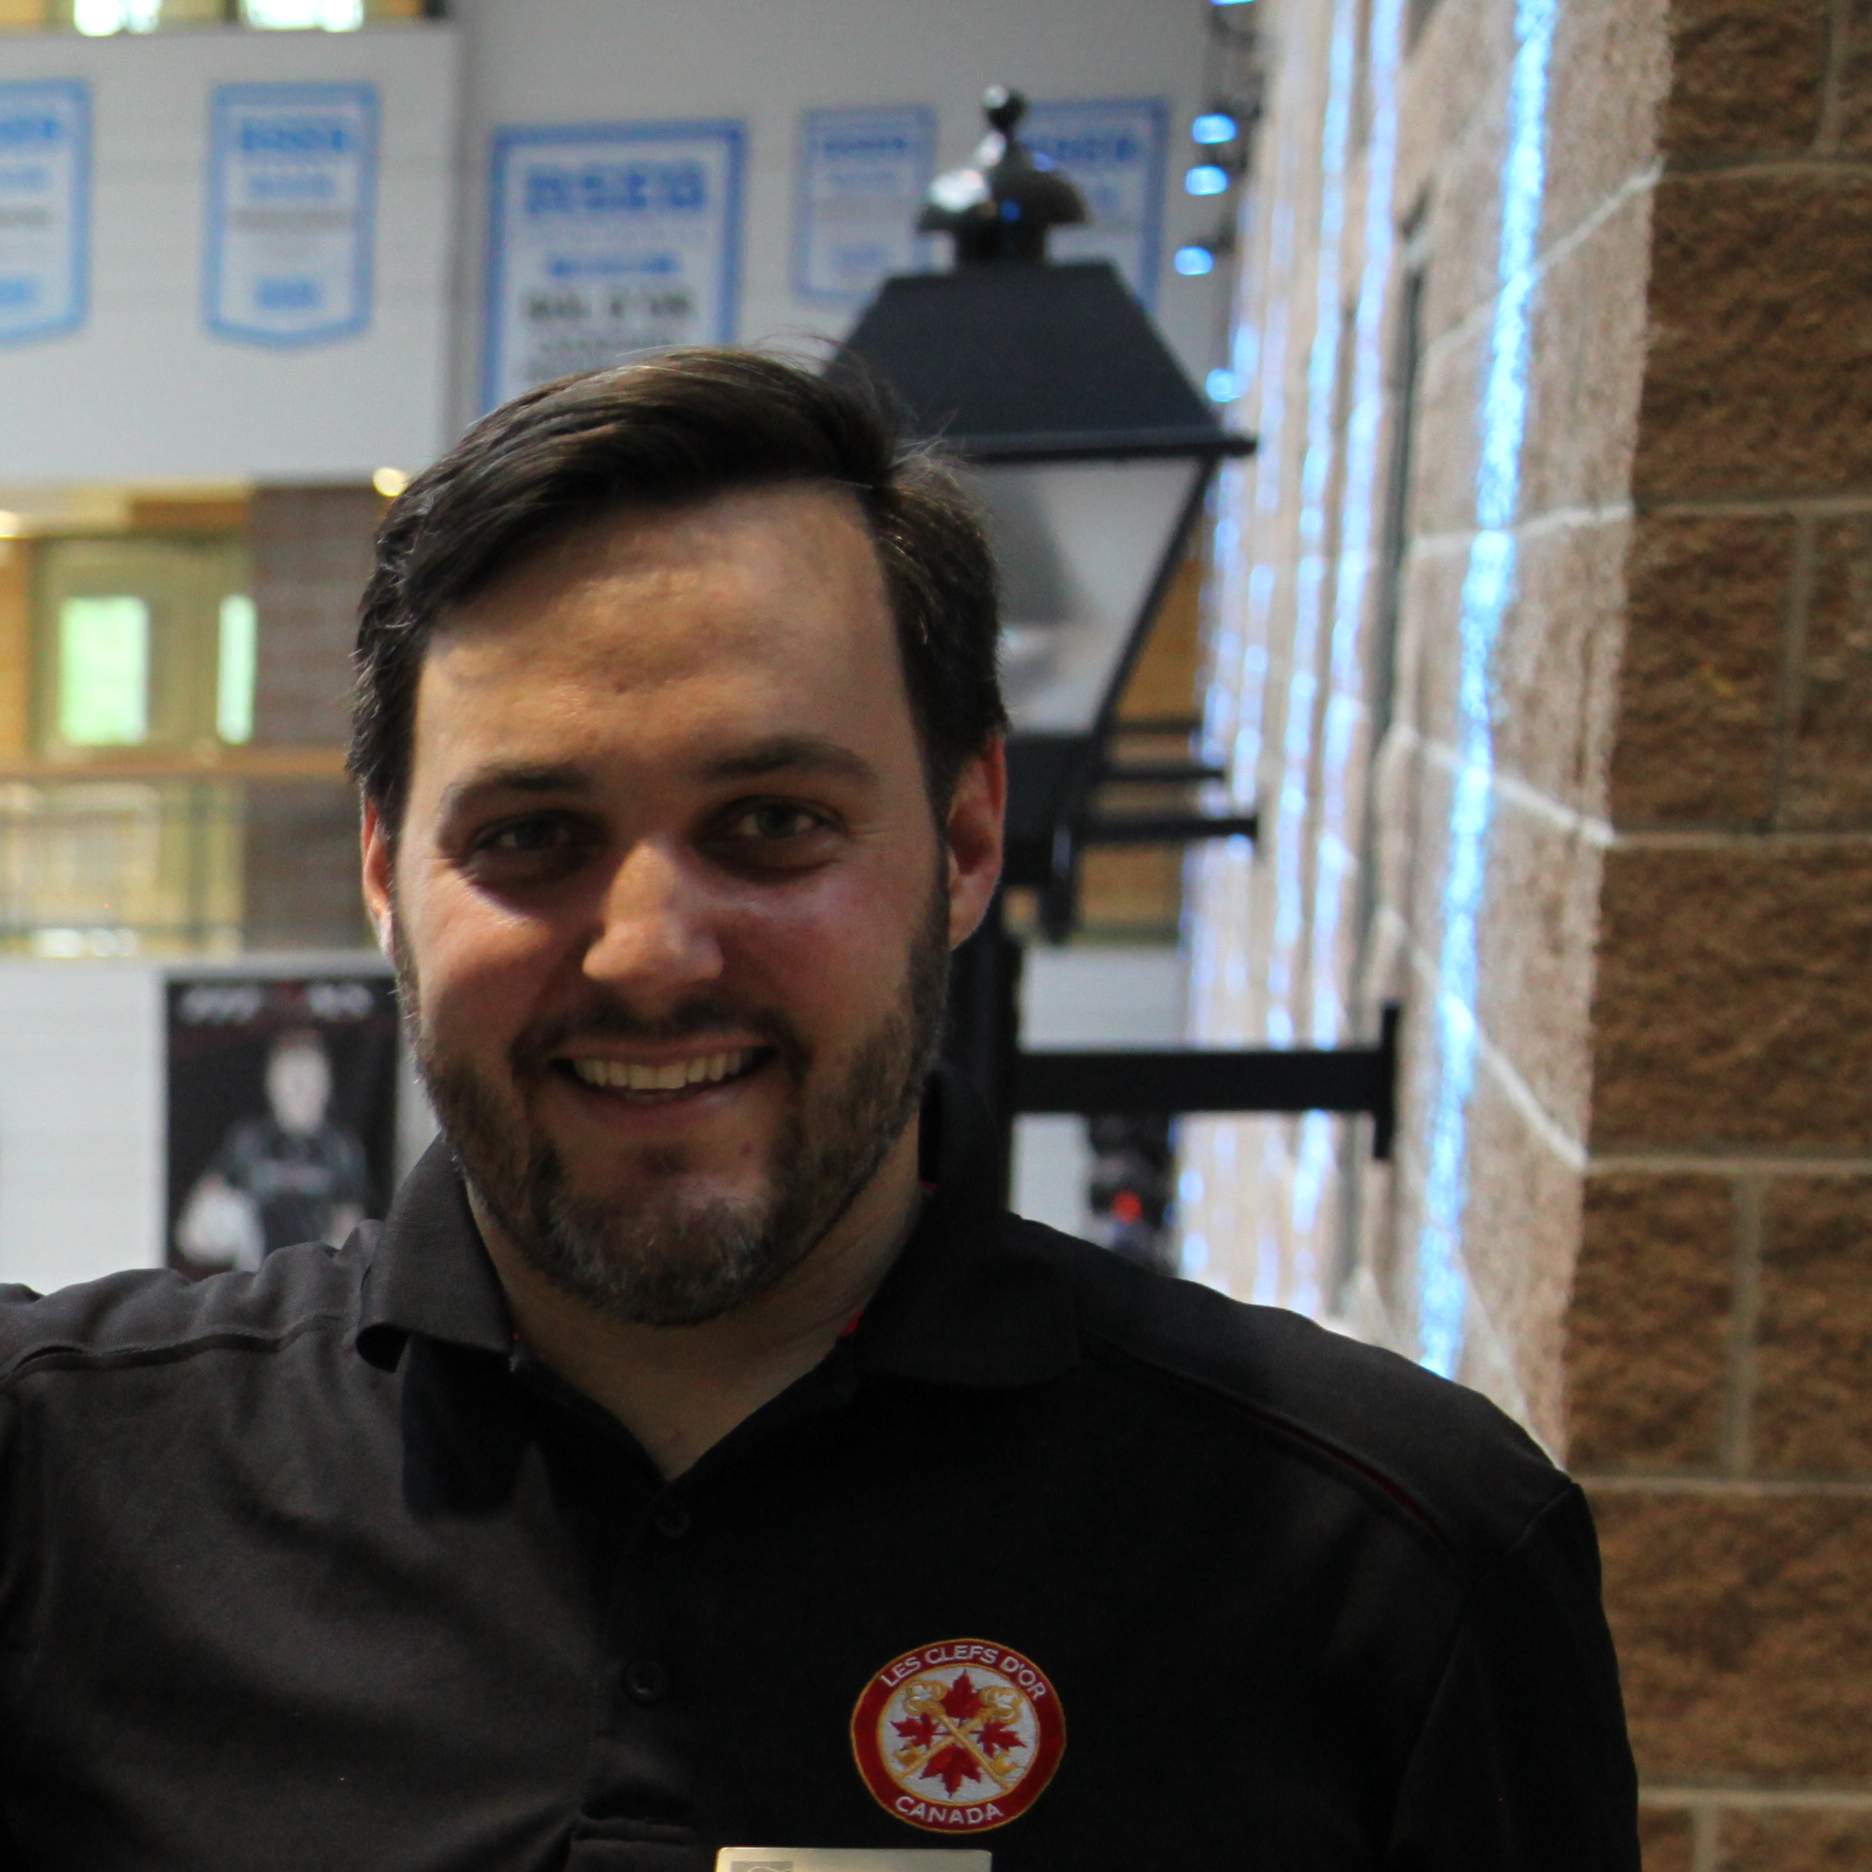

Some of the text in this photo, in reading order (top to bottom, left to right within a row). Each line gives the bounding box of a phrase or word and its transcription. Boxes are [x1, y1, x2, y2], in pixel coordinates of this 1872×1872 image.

[880, 1645, 1046, 1701] LES CLEFS D'OR
[895, 1795, 1005, 1826] CANADA
